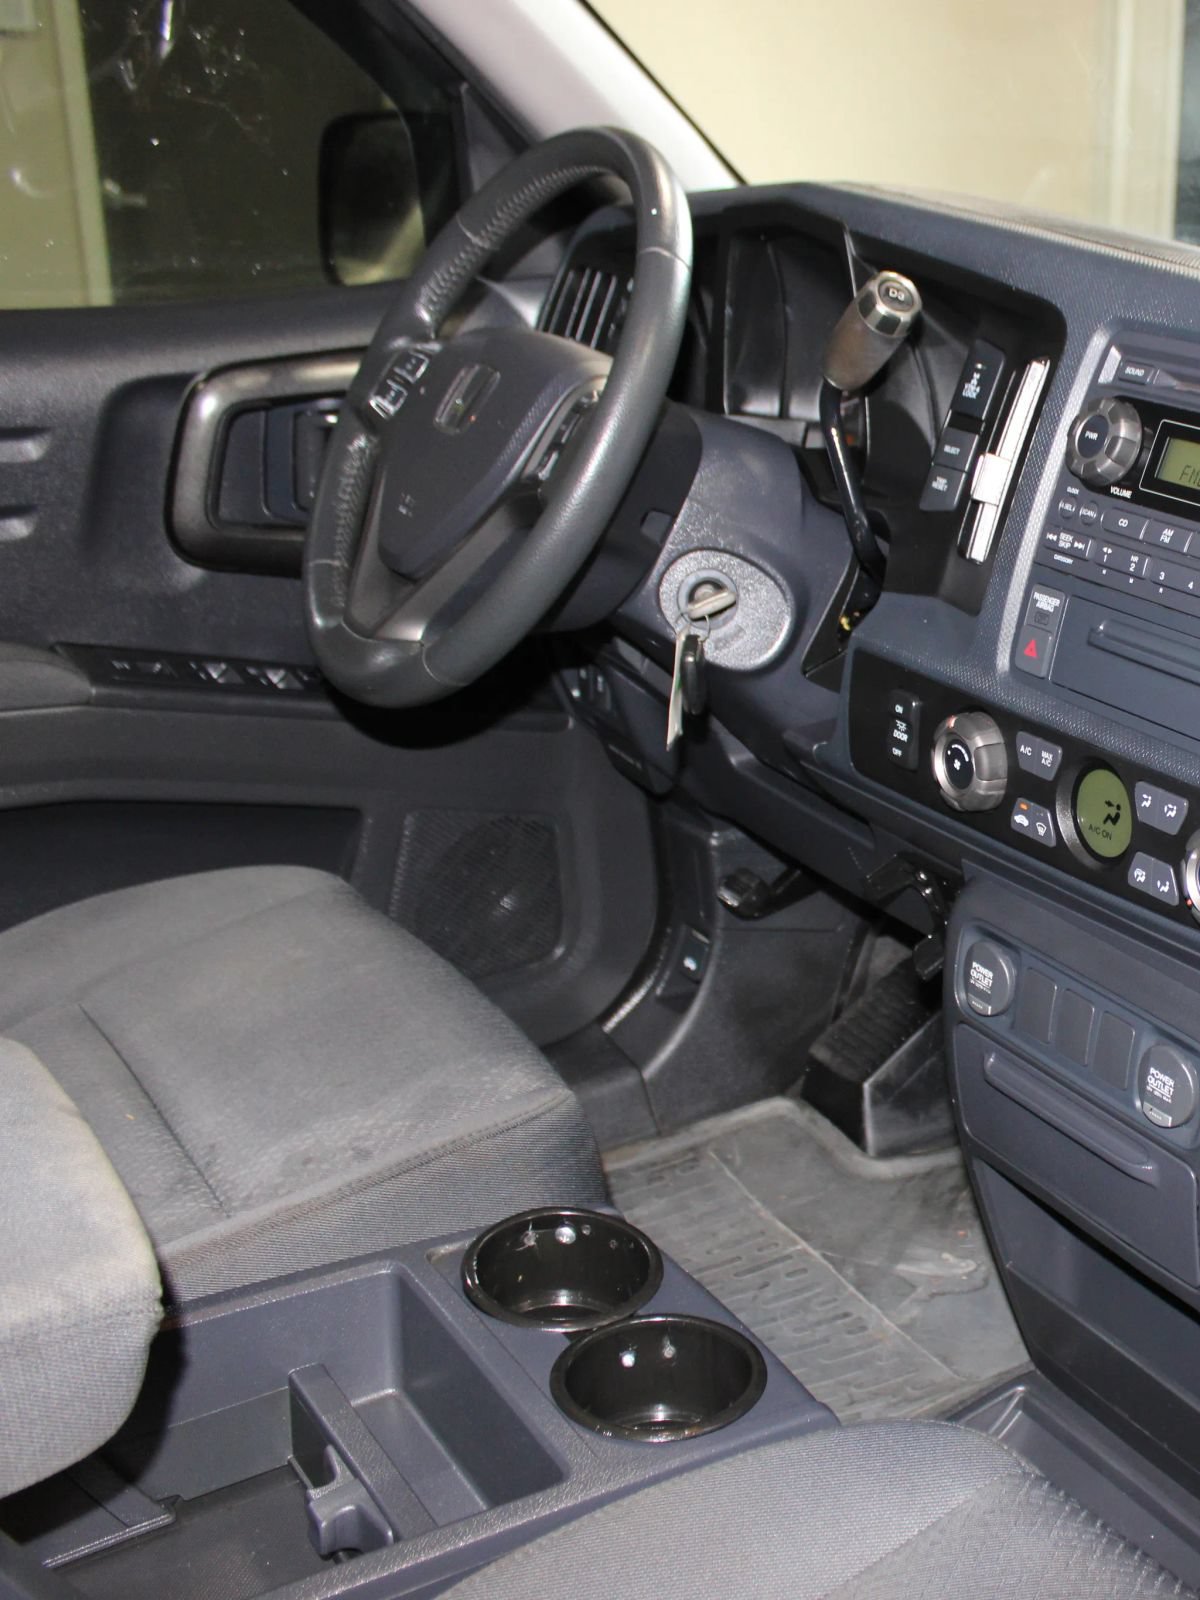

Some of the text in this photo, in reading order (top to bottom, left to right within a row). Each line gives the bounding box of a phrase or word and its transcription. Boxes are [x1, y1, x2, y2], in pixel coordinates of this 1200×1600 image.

[1125, 366, 1145, 377] SOUND
[1084, 430, 1098, 441] PWR
[1110, 485, 1133, 499] VOLUME
[1118, 518, 1128, 527] CD
[1060, 532, 1073, 543] SEEK
[1162, 528, 1174, 537] AM
[1058, 540, 1071, 549] SKIP
[1160, 535, 1171, 544] FM
[1103, 554, 1108, 563] 1
[1129, 562, 1136, 572] 2
[1159, 571, 1165, 580] 3
[1187, 581, 1194, 590] 4
[1033, 591, 1061, 607] PASSENGER
[1035, 600, 1055, 613] AIRBAG
[895, 705, 904, 714] ON
[893, 729, 908, 743] DOOR
[1020, 744, 1032, 756] A/C
[1041, 750, 1053, 761] MAX
[1041, 758, 1053, 768] A/C
[1088, 823, 1113, 841] A/C ON
[972, 961, 993, 980] POWER
[970, 968, 993, 987] OUTLET
[1150, 1066, 1175, 1088] POWER
[1147, 1075, 1175, 1096] OUTLET
